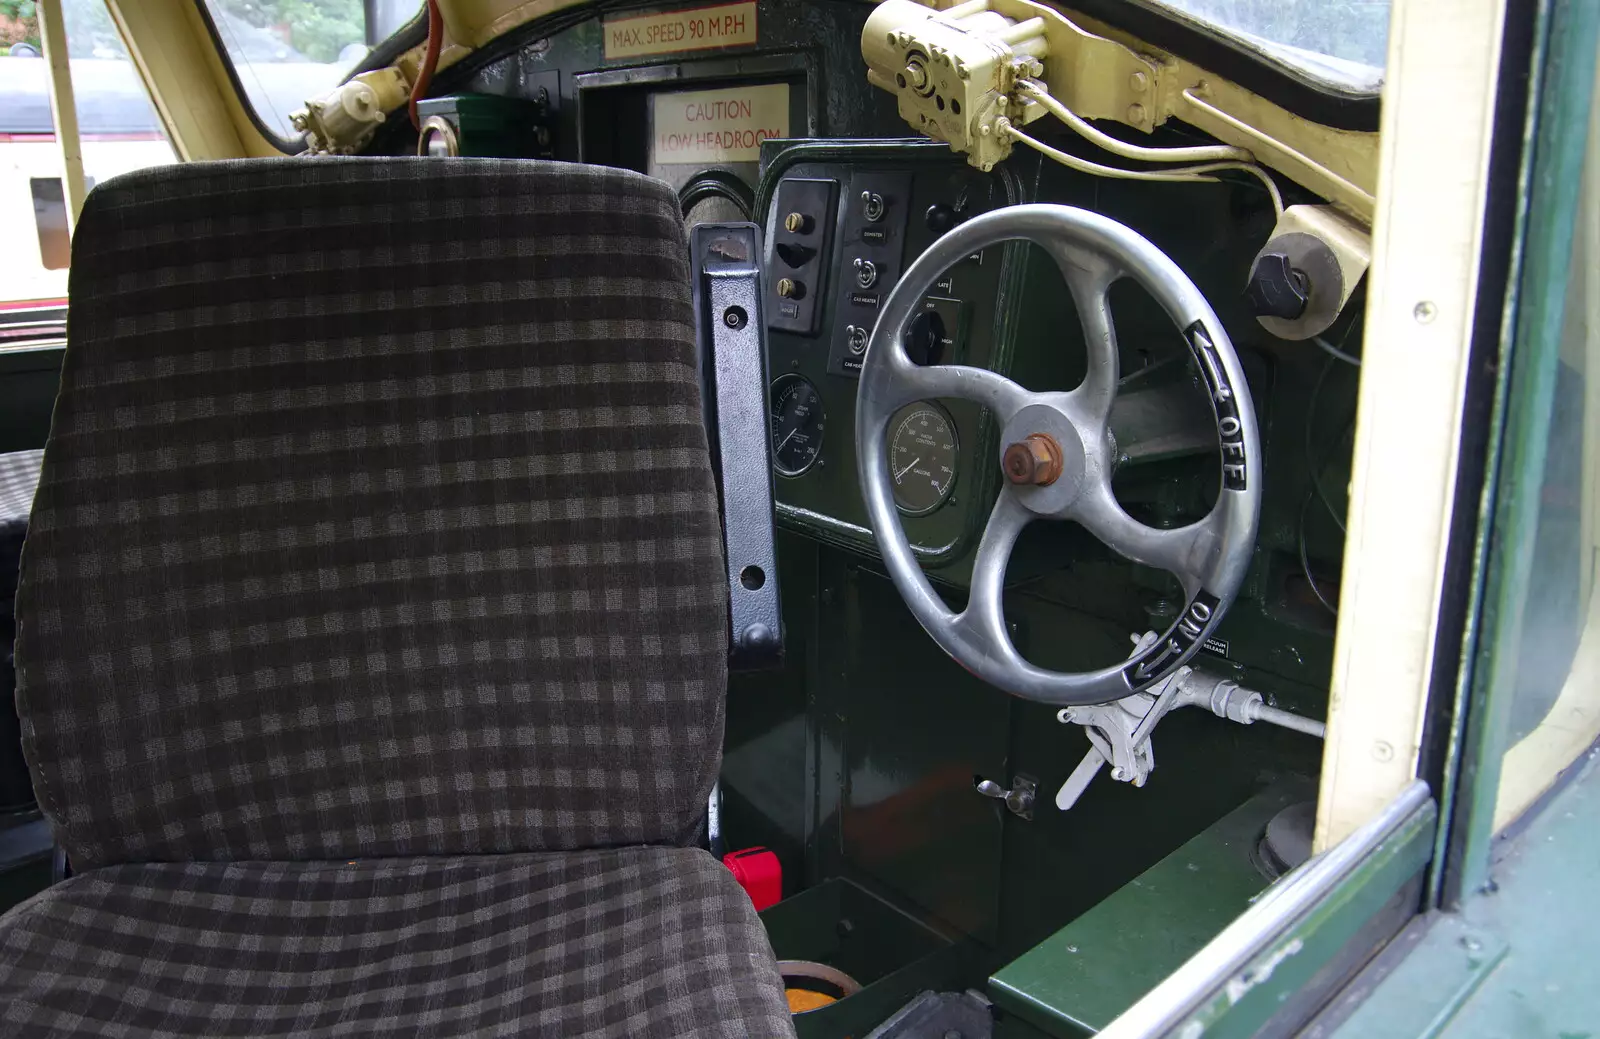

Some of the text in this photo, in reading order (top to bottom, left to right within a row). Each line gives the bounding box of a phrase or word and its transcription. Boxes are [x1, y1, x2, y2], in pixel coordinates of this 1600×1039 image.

[612, 13, 746, 49] MAX. SPEED 90 M.P.H
[685, 99, 752, 122] CAUTION
[661, 133, 693, 152] LOW
[1218, 416, 1245, 482] OFF
[1179, 601, 1211, 640] ON
[1203, 643, 1225, 655] RELEASE
[1206, 638, 1226, 649] ACUUM
